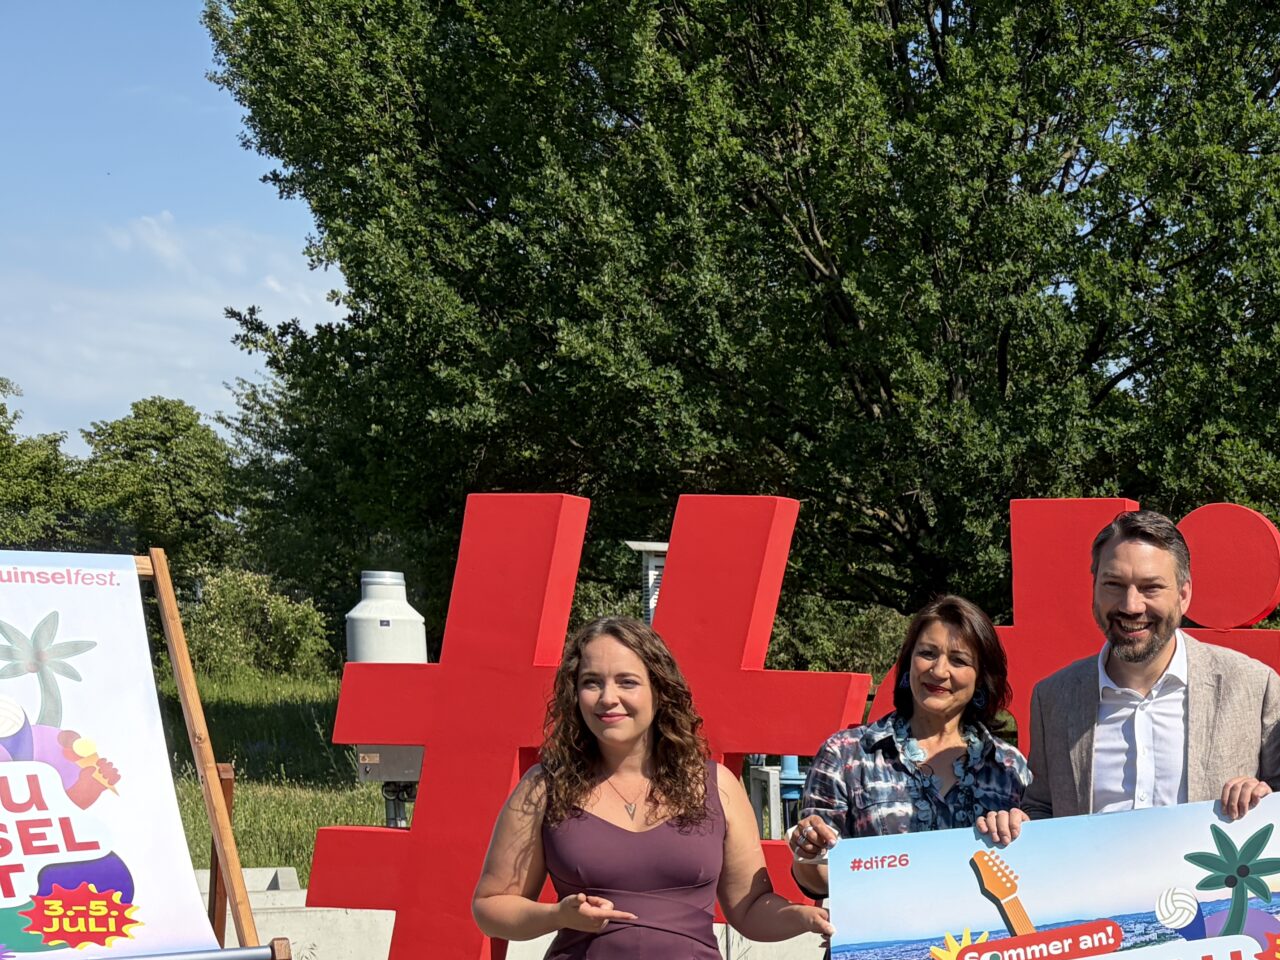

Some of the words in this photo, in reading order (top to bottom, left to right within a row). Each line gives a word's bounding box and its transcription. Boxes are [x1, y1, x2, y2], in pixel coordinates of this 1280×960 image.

[0, 816, 101, 858] EL
[850, 853, 909, 871] #dif26
[43, 917, 117, 933] JULI
[1078, 925, 1116, 948] an!
